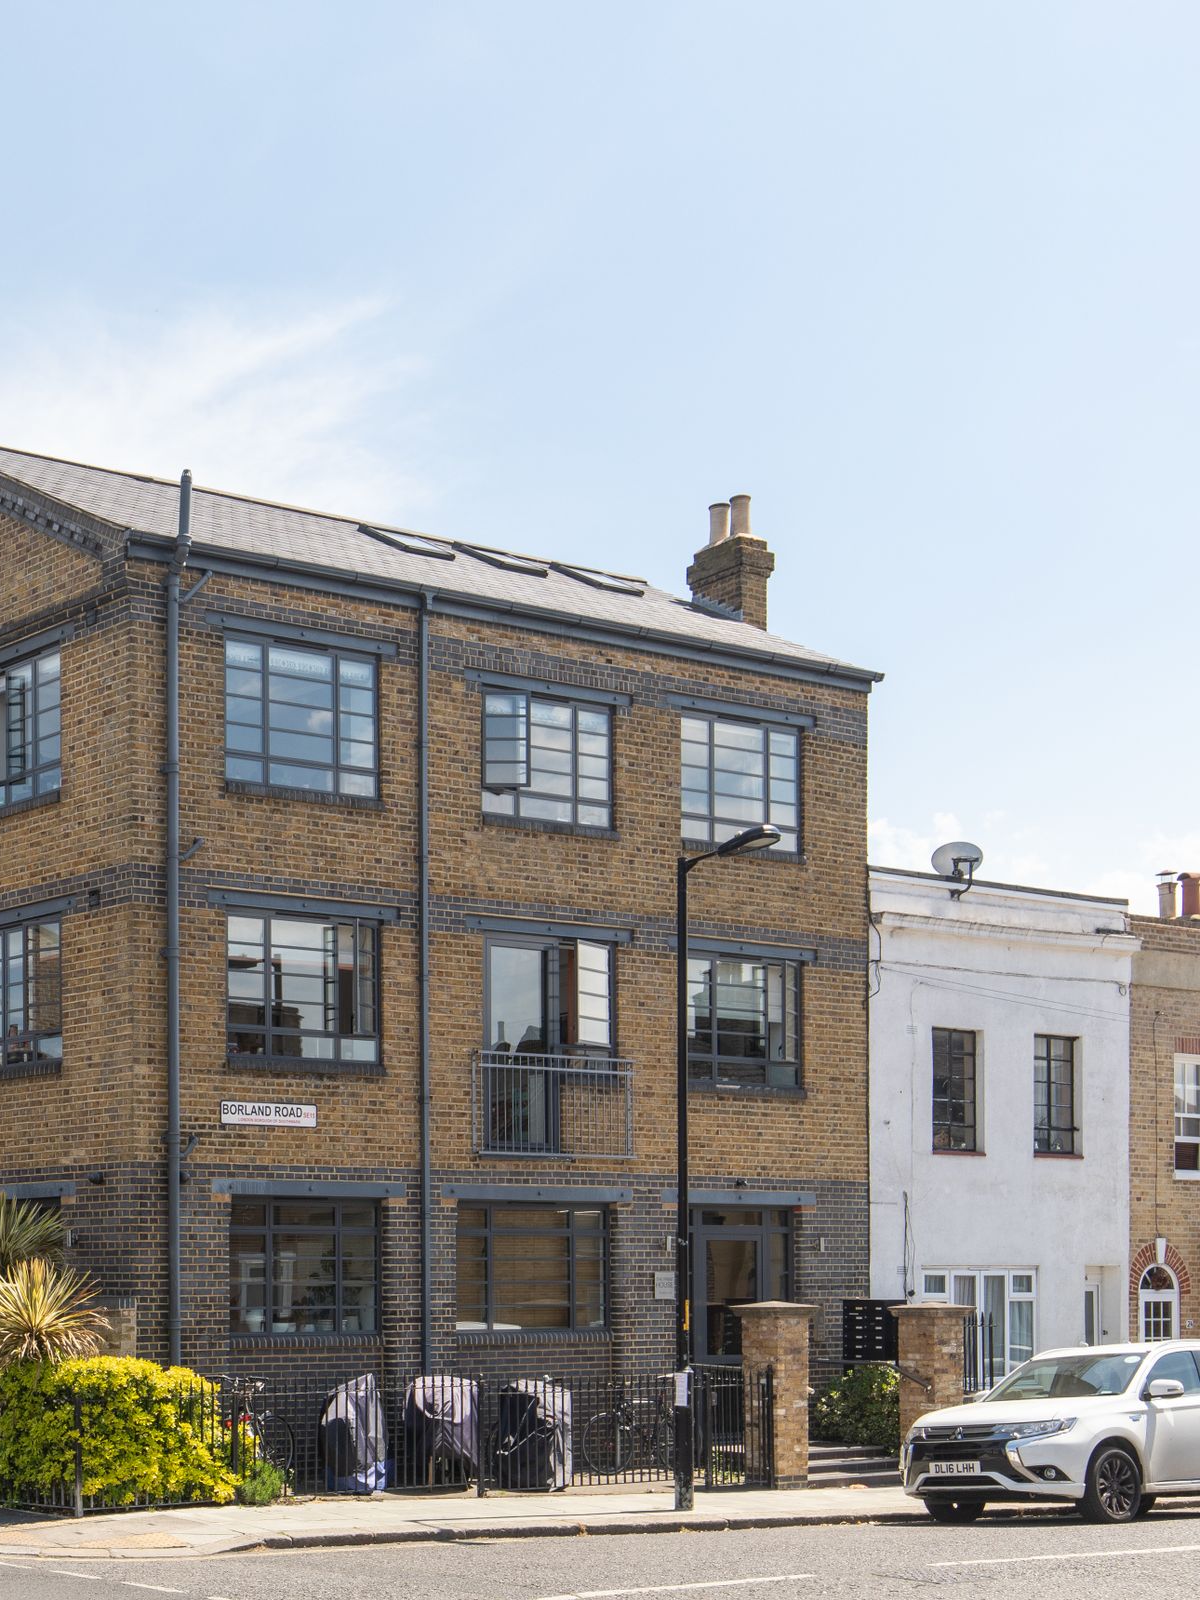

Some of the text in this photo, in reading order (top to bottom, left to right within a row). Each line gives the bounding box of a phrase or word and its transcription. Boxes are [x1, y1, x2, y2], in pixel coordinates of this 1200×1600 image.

[222, 1103, 272, 1117] BORLAND
[274, 1106, 303, 1118] ROAD
[935, 1462, 975, 1474] DL16 LHH
